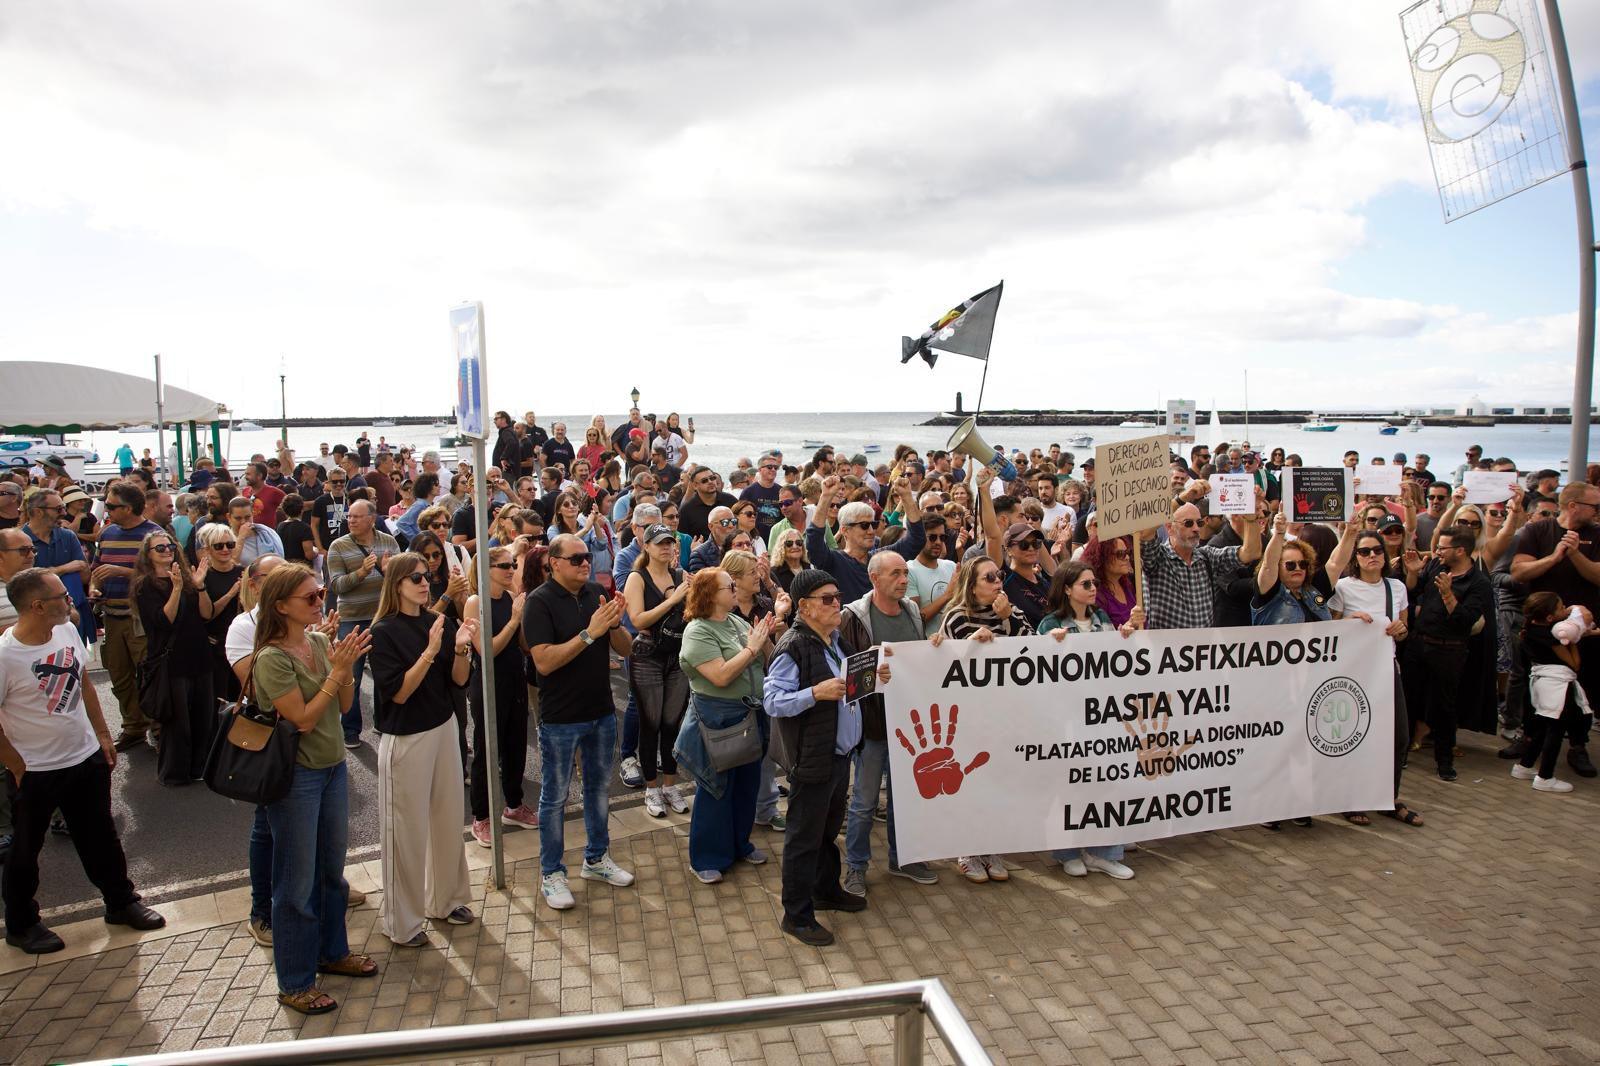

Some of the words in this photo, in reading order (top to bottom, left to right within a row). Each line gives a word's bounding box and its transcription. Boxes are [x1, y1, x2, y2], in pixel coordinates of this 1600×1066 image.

[1108, 442, 1150, 464] DERECHO
[1153, 440, 1160, 452] A
[1110, 454, 1163, 476] VACACIONES
[1124, 475, 1168, 497] DESCANSO
[1104, 508, 1121, 526] NO
[1125, 494, 1171, 519] FINANCIO!!
[1328, 499, 1337, 507] 30
[942, 646, 1151, 688] AUTÓNOMOS
[1158, 636, 1338, 674] ASFIXIADOS!!
[1084, 691, 1173, 725] BASTA
[1177, 685, 1230, 716] YA!!
[1322, 699, 1351, 724] 30
[1348, 684, 1367, 715] NACIONAL
[1014, 735, 1141, 762] “PLATAFORMA
[1147, 731, 1180, 751] POR
[1184, 728, 1204, 745] LA
[1208, 720, 1285, 742] DIGNIDAD
[1312, 735, 1321, 746] DE
[1320, 731, 1362, 754] AUTONOMOS
[1331, 724, 1342, 740] N
[1069, 767, 1092, 784] DE
[1097, 762, 1130, 782] LOS
[1133, 748, 1245, 778] AUTÓNOMOS”
[1063, 786, 1231, 831] LANZAROTE
